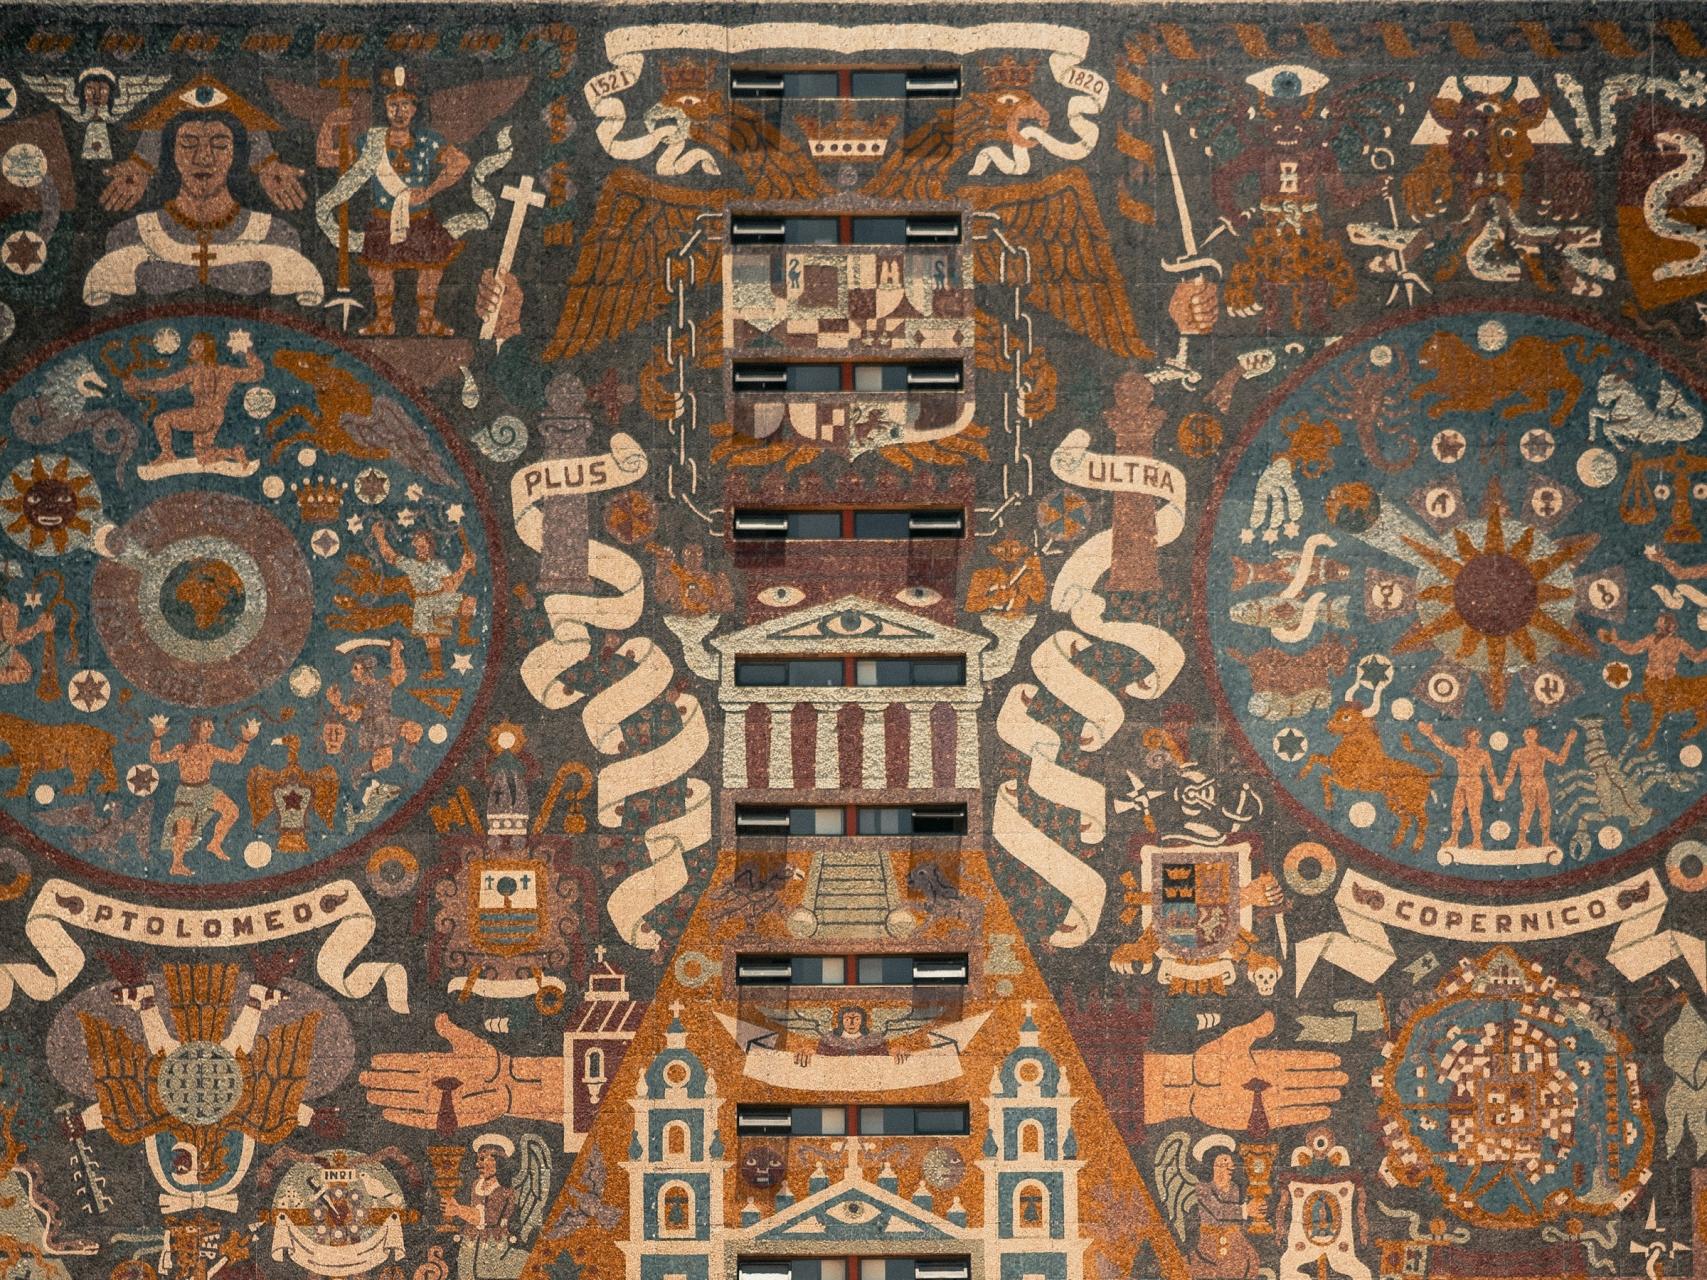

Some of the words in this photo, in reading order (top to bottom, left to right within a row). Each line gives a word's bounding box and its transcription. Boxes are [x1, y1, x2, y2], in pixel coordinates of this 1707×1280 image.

[589, 70, 630, 97] 1521
[1068, 68, 1104, 95] 1820
[524, 461, 607, 496] PLUS
[1088, 461, 1174, 494] ULTRA
[94, 902, 313, 939] PTOLOMEO
[1394, 899, 1607, 934] COPERNICO
[324, 1170, 352, 1180] INRI
